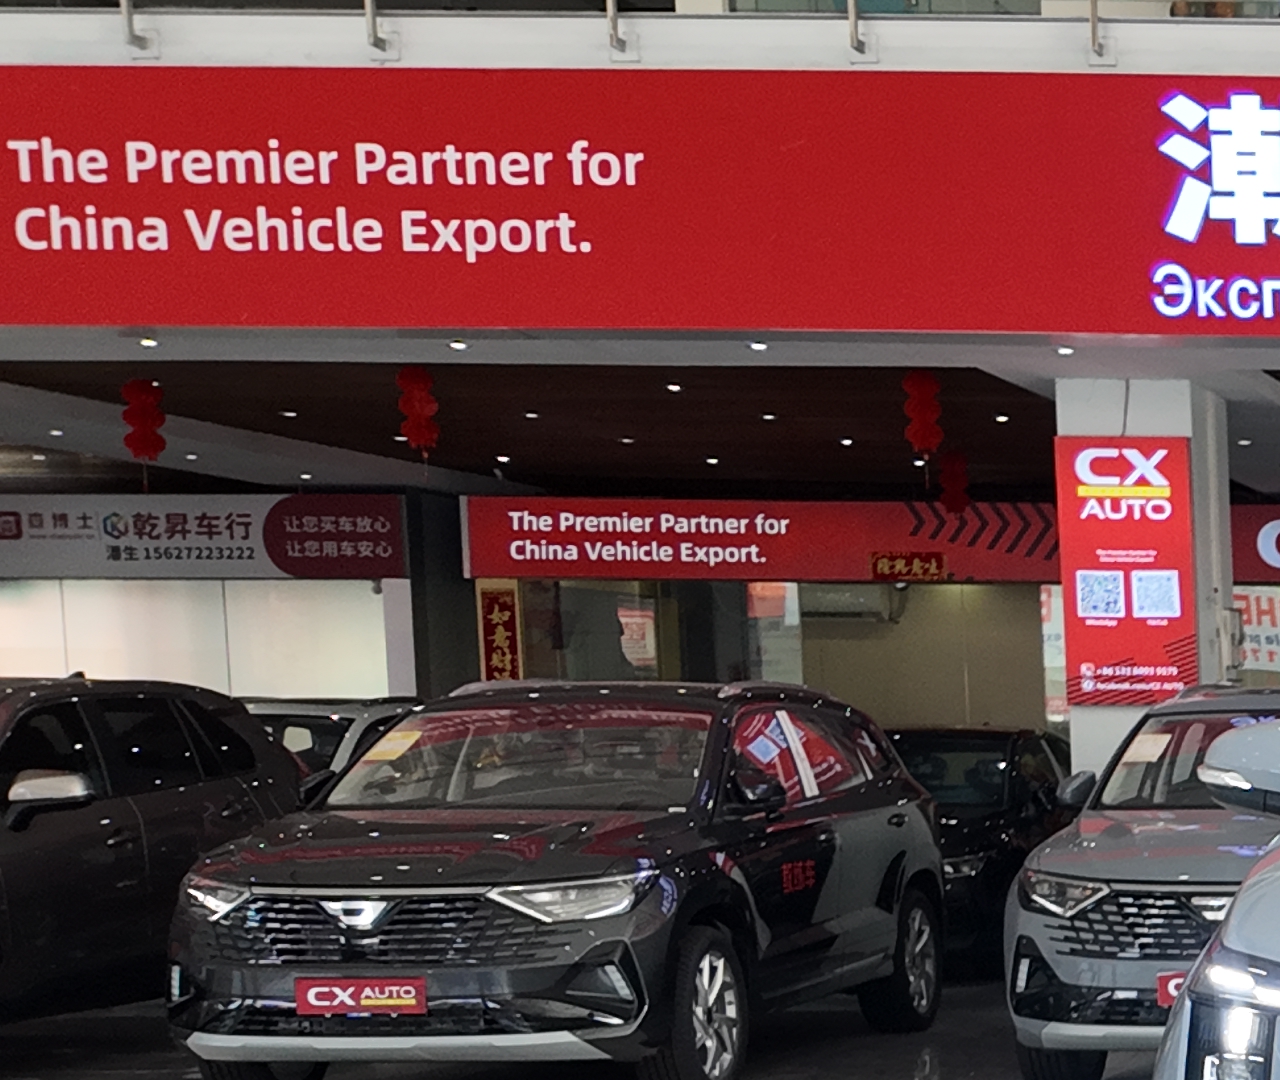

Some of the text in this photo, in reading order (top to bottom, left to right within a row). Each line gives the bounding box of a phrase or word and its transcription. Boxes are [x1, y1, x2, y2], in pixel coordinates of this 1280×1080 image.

[7, 138, 644, 187] The Premier Partner for
[14, 205, 592, 263] China Vehicle Export.
[1074, 447, 1170, 486] CX
[1080, 498, 1172, 520] AUTO
[131, 512, 252, 540] 乾昇车行
[283, 516, 391, 533] 让您买车放心
[508, 511, 789, 535] The Premier Partner for
[144, 546, 255, 560] 15627223222
[286, 541, 392, 557] 让您用车安心
[510, 540, 766, 567] China Vehicle Export.
[307, 986, 356, 1006] CX
[360, 986, 416, 998] AUTO
